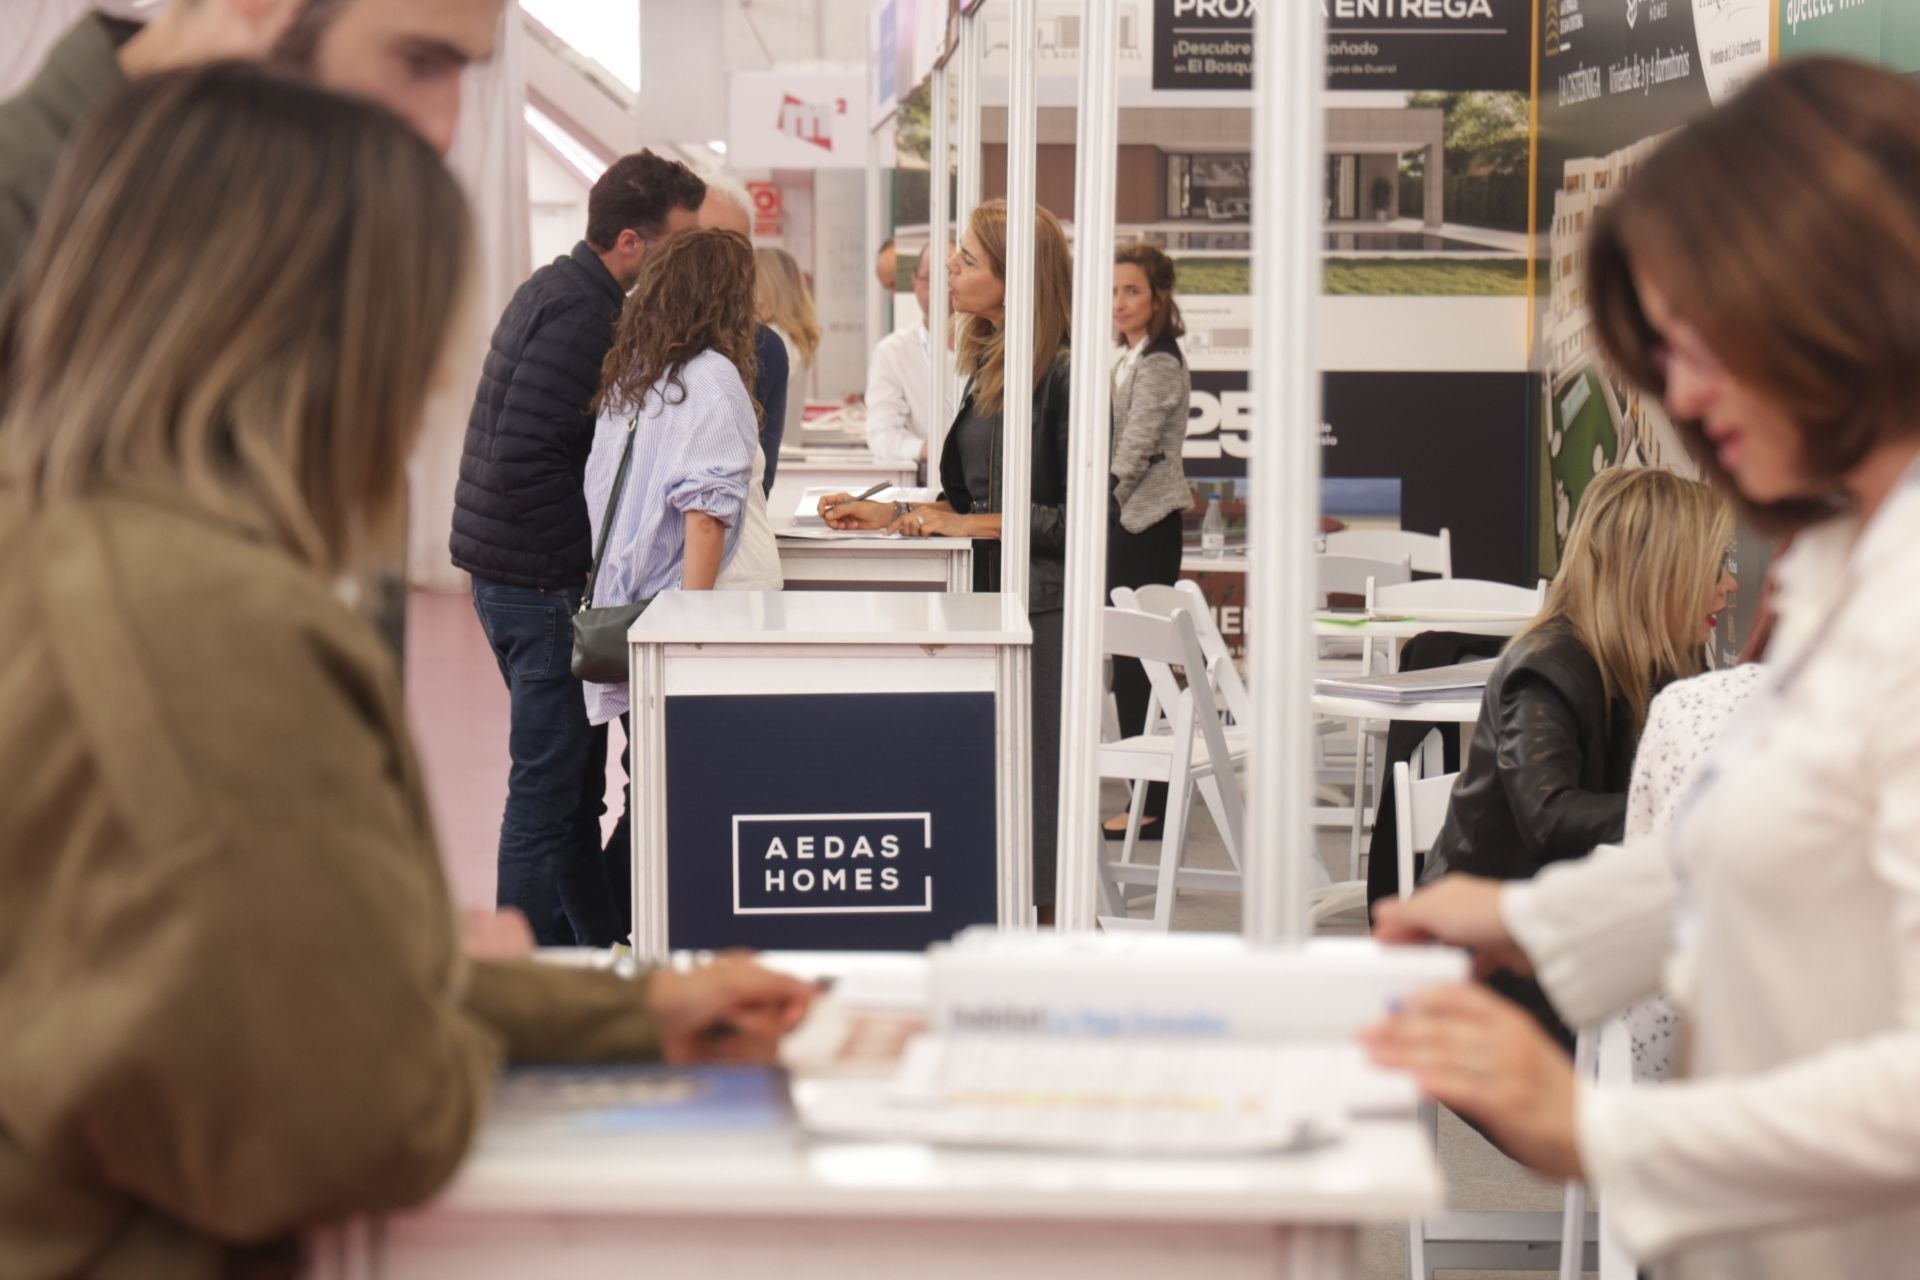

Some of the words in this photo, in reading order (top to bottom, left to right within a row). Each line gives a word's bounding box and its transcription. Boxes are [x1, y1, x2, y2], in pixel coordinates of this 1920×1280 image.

[1204, 59, 1255, 76] Bosqu
[765, 835, 900, 859] AEDAS
[765, 867, 900, 892] HOMES
